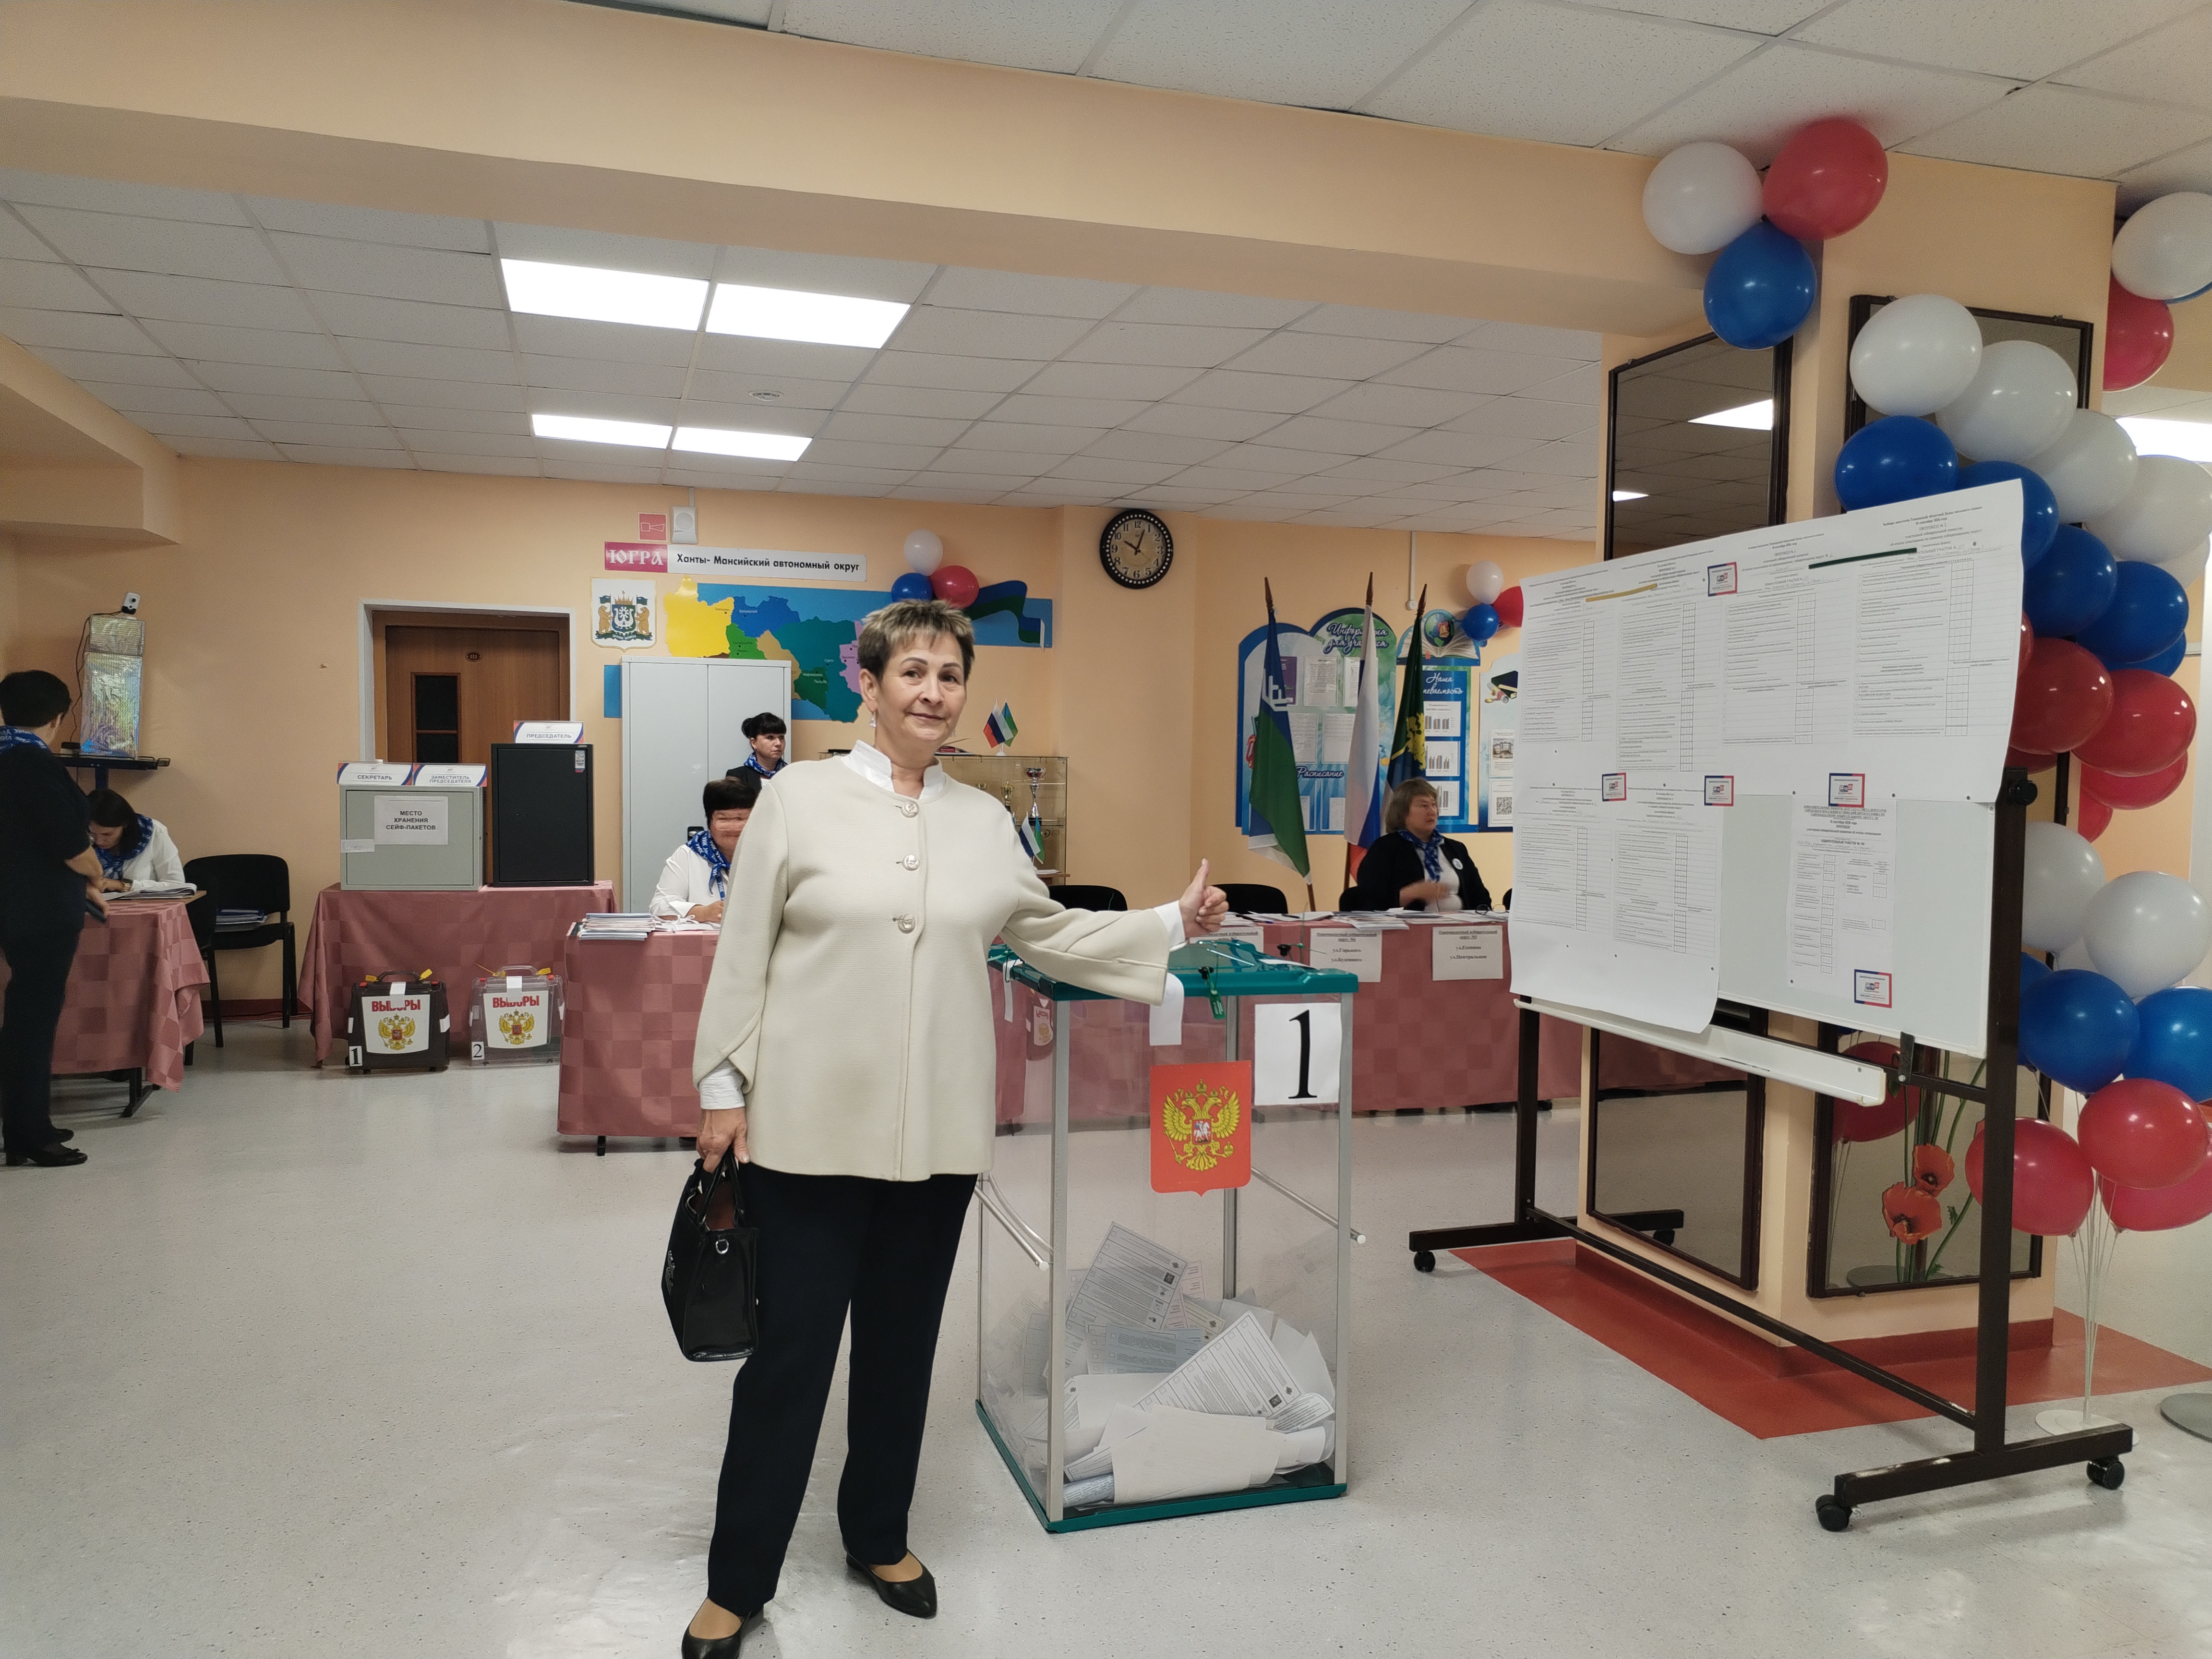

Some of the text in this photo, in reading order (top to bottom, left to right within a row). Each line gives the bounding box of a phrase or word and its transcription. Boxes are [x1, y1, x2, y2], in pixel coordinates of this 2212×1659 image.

[1123, 523, 1129, 531] 11
[1148, 524, 1151, 532] 1
[1115, 532, 1121, 540] 10
[1154, 533, 1161, 541] 2
[1111, 544, 1118, 553] 9
[1157, 546, 1163, 554] 3
[609, 550, 860, 573] ЮГРА Ханты- Мансийский автономный округ
[1114, 557, 1120, 565] 8
[1153, 558, 1159, 567] 4
[1122, 566, 1129, 575] 7
[1133, 570, 1140, 578] 6
[1145, 567, 1152, 576] 5
[1328, 624, 1387, 640] Инфория
[1344, 639, 1387, 653] учася
[1426, 673, 1453, 683] Наша
[1296, 767, 1344, 777] Расписание
[372, 999, 421, 1012] ВЫРЫ
[473, 1044, 482, 1058] 2
[1288, 1010, 1317, 1099] 1
[351, 1048, 361, 1065] 1
